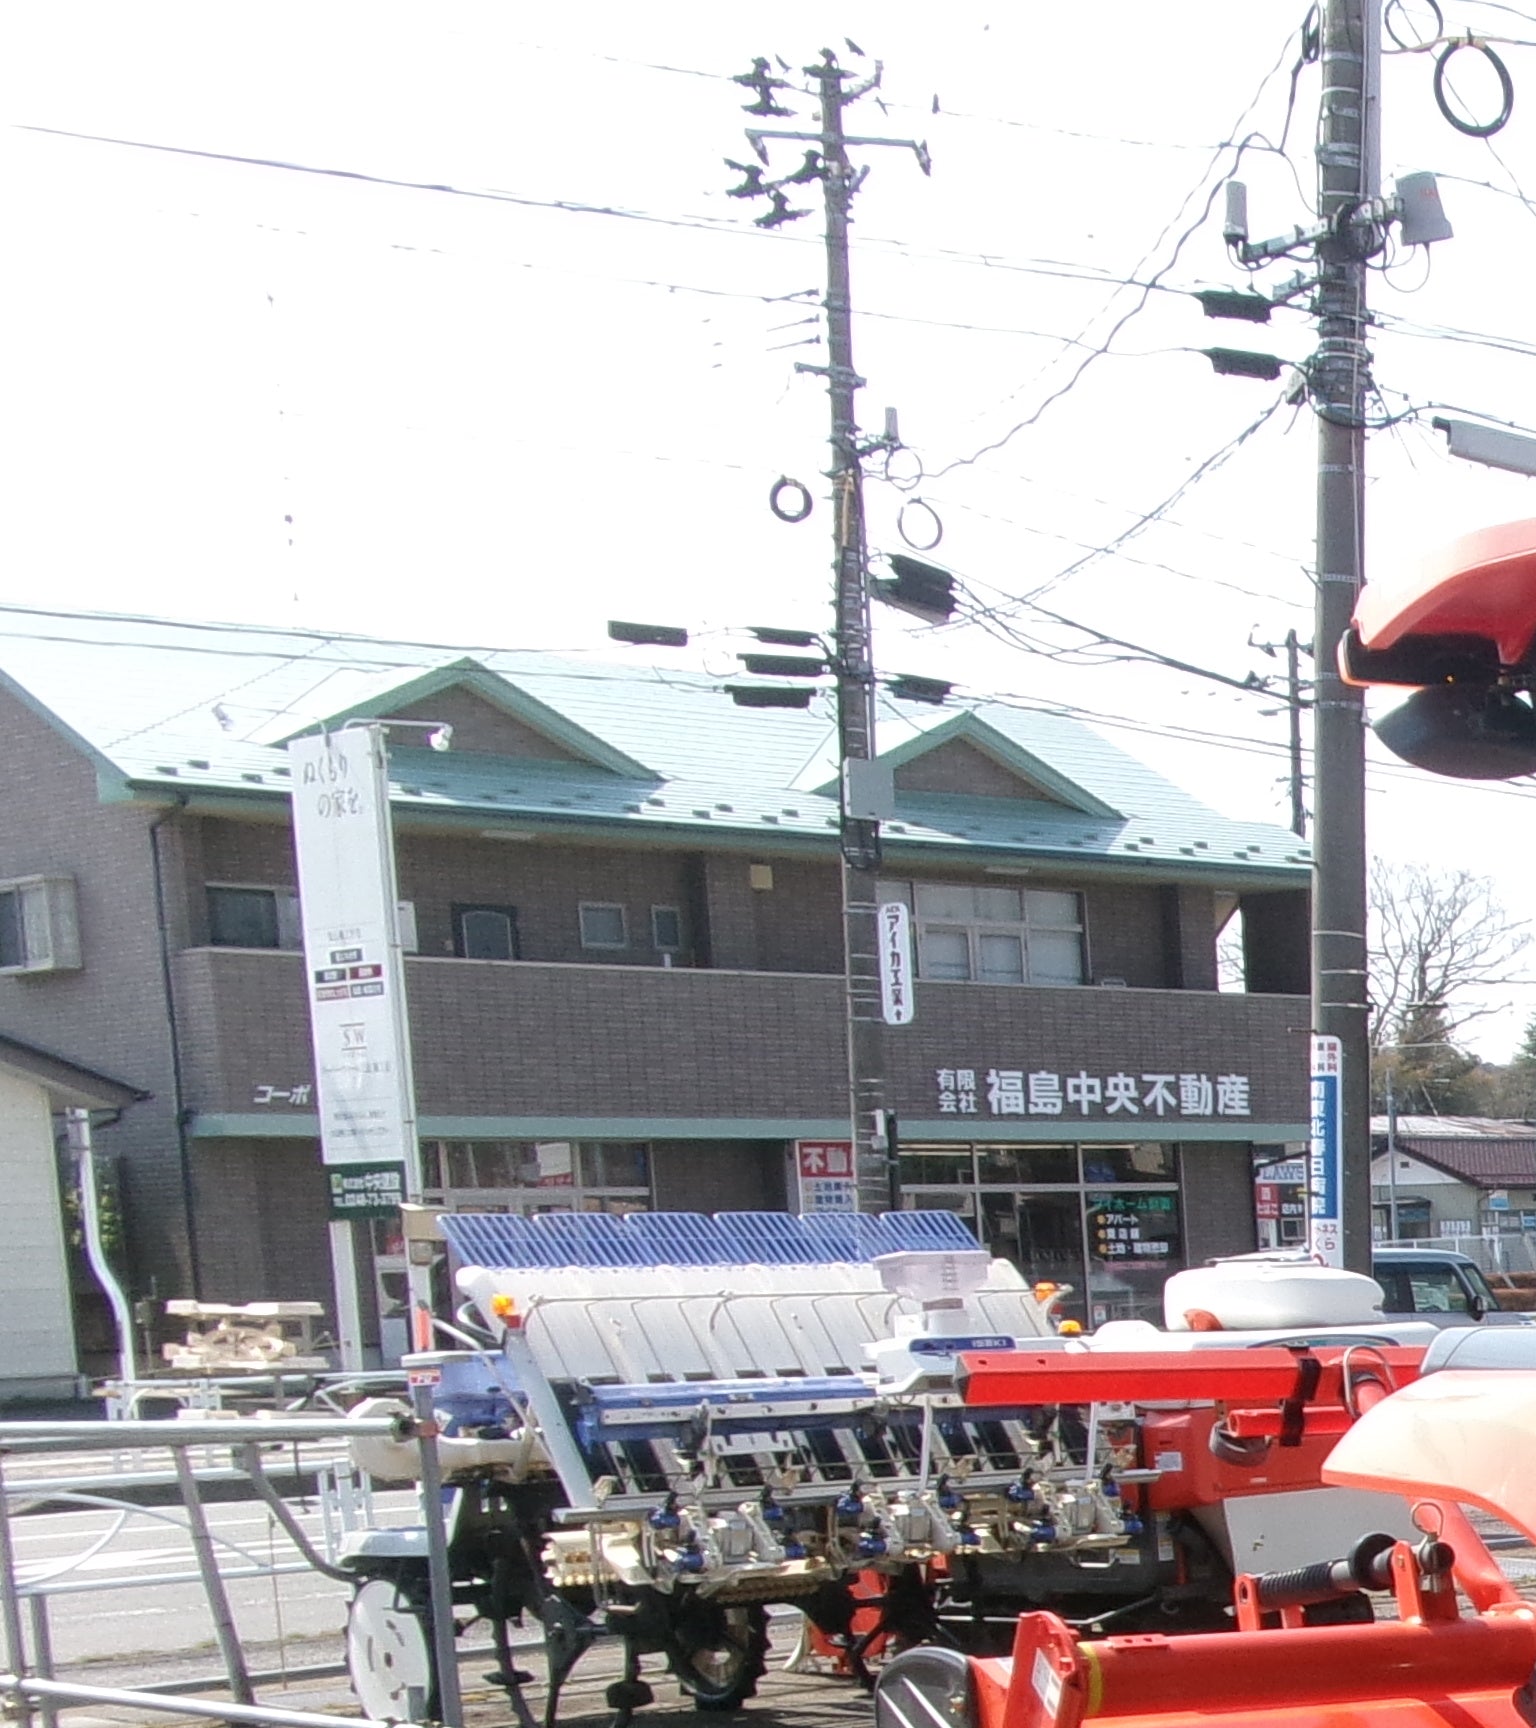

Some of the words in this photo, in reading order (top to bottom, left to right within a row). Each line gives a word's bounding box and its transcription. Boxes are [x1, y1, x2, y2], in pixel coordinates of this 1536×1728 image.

[936, 1068, 976, 1091] 有限
[253, 1084, 312, 1105] コーポ
[938, 1091, 978, 1114] 会社
[985, 1068, 1252, 1116] 福島中央不動産
[1106, 1214, 1139, 1225] アパート
